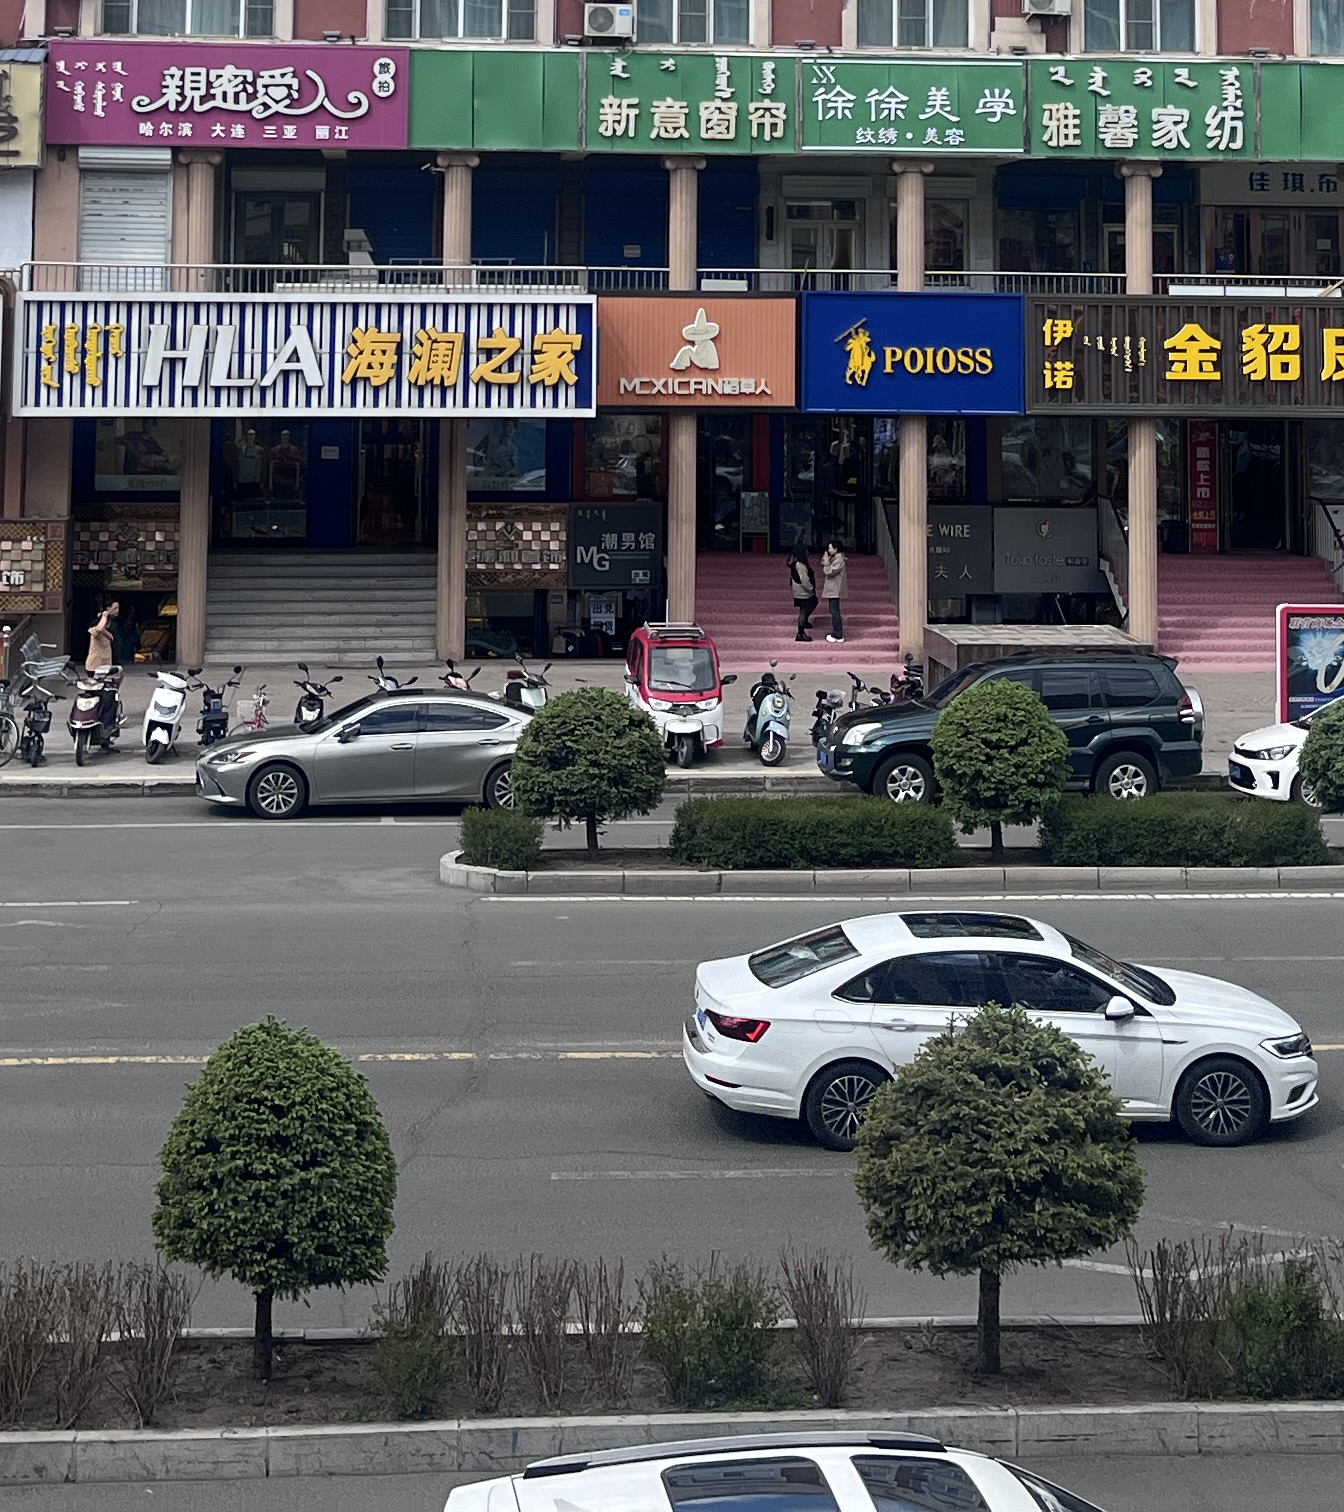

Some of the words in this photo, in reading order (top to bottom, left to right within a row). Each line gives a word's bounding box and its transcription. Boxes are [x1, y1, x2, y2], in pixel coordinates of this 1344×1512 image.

[374, 59, 394, 98] 旅拍
[598, 95, 787, 141] 新意窗帘
[812, 86, 1017, 124] 徐徐美学
[139, 121, 193, 139] 哈尔滨
[211, 124, 246, 140] 大连
[262, 126, 298, 140] 三亚
[315, 125, 349, 141] 丽江
[1042, 103, 1245, 151] 雅馨家纺
[142, 324, 324, 388] HLA
[342, 326, 583, 387] 海澜之家
[883, 346, 994, 375] POIOSS
[1042, 318, 1075, 389] 伊诺
[601, 531, 656, 551] 潮男馆
[939, 524, 971, 538] WIRE
